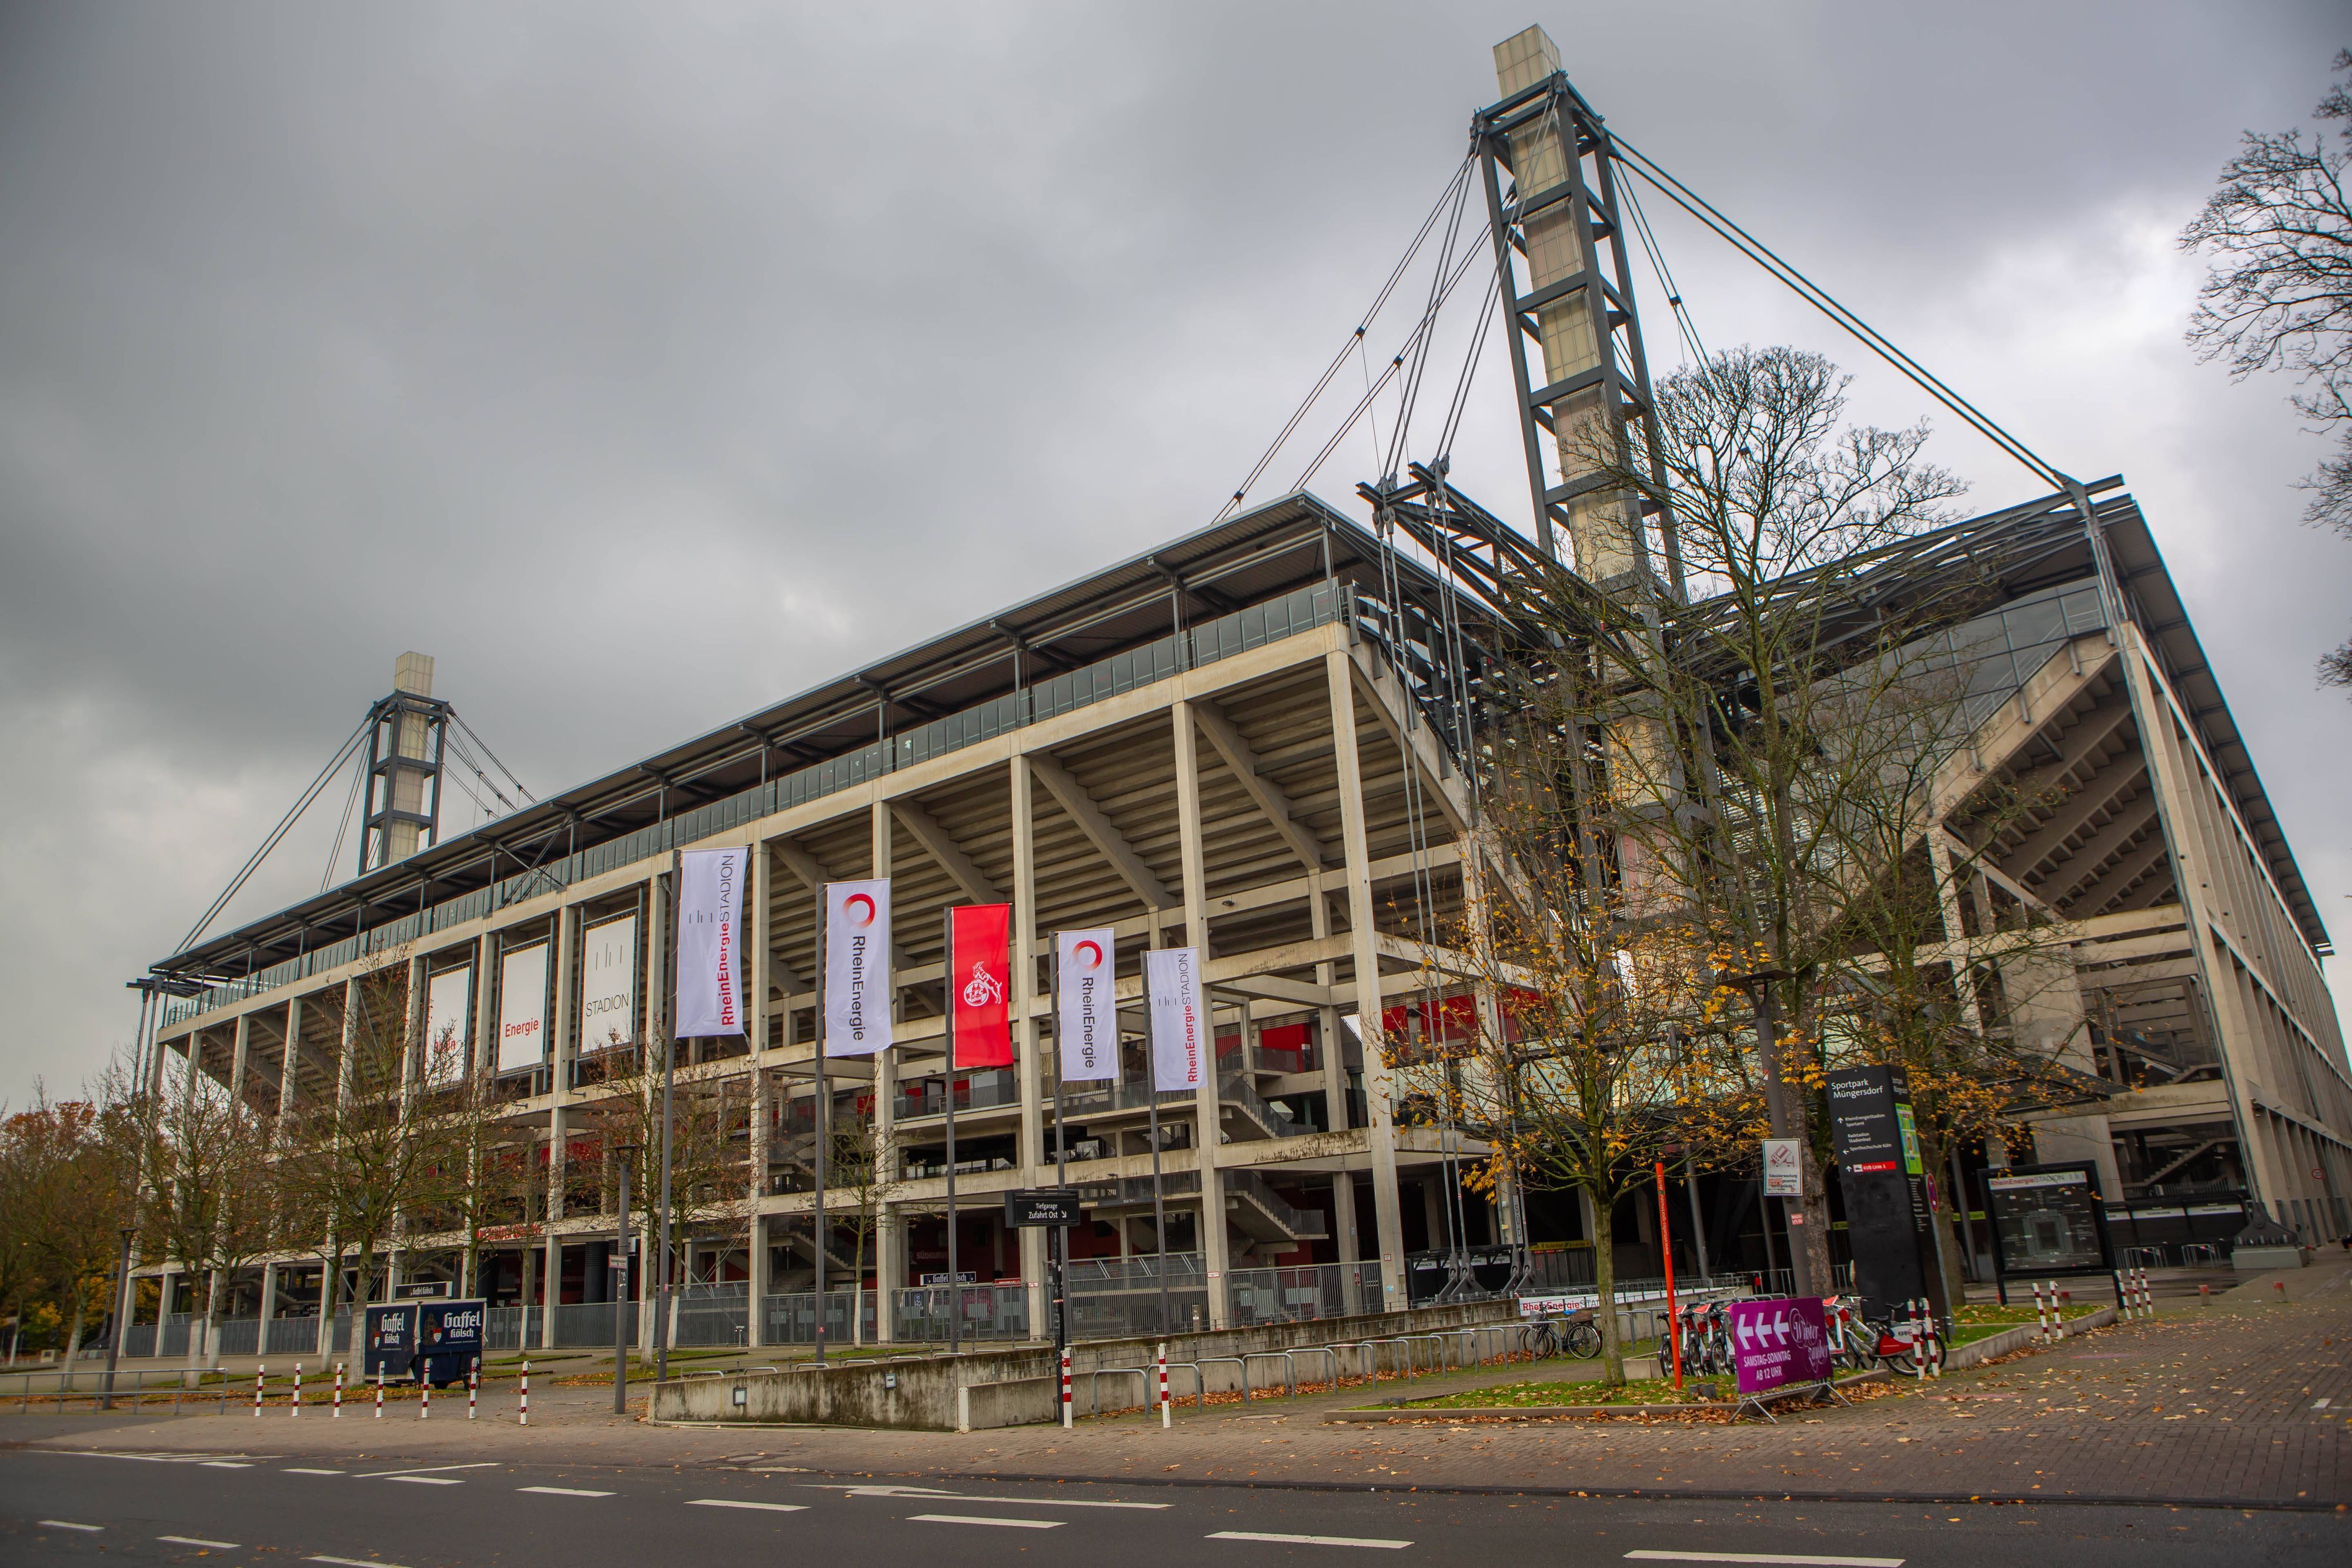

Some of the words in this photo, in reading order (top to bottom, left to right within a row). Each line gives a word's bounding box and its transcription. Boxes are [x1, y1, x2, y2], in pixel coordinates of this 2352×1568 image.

[717, 854, 735, 1027] RheinEnergieSTADION
[852, 935, 866, 1041] RheinEnergie
[586, 992, 629, 1018] STADION
[1082, 977, 1095, 1069] RheinEnergie
[1178, 953, 1198, 1082] RheinEnergieSTADION
[505, 1018, 539, 1038] Energie
[1831, 1078, 1869, 1090] Sportpark
[1833, 1085, 1883, 1099] Müngersdorf
[933, 1274, 949, 1283] Gaffel
[956, 1273, 967, 1282] lsch
[381, 1312, 405, 1333] Gaffel
[444, 1310, 482, 1329] Gaffel
[1743, 1350, 1791, 1367] SAMSTAG-SONNTAG
[1756, 1370, 1763, 1381] AB
[1763, 1368, 1770, 1379] 12
[1770, 1366, 1782, 1377] UHR
